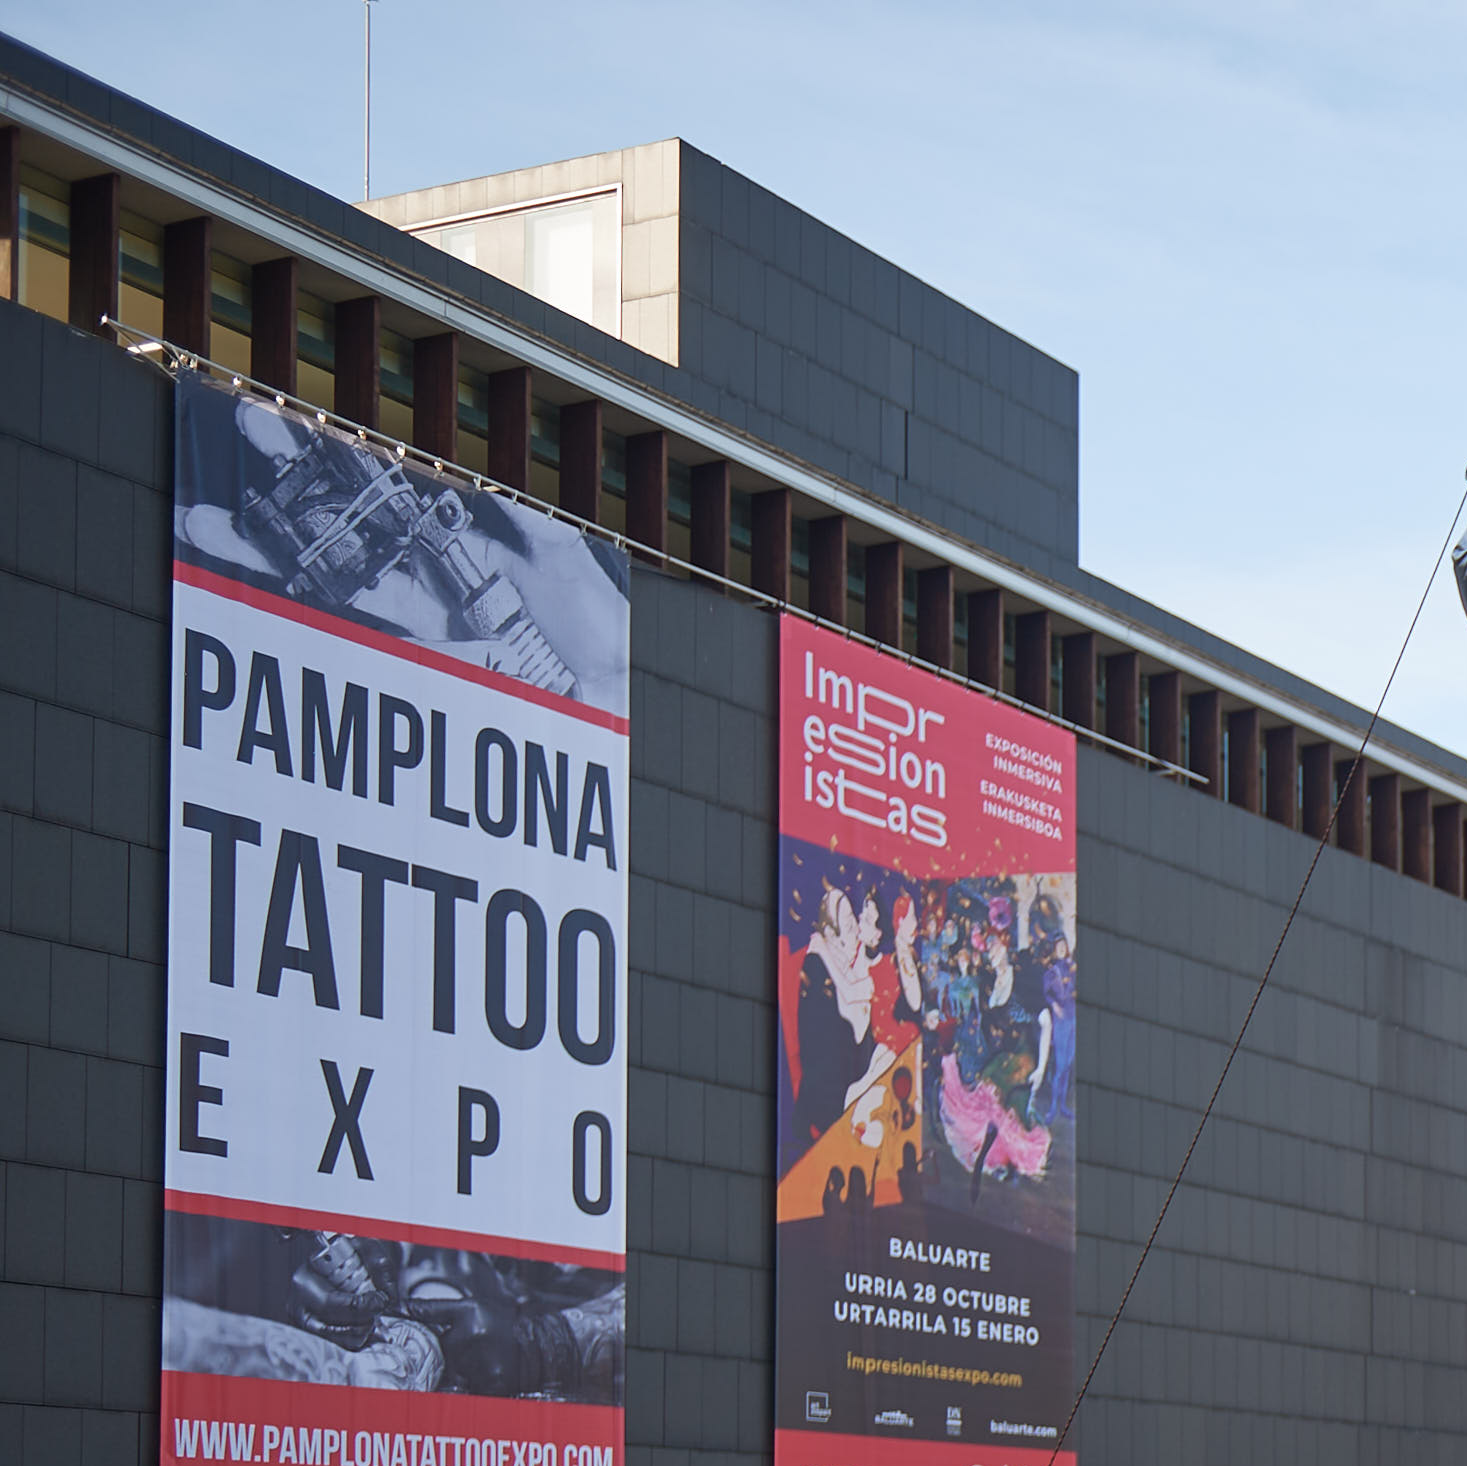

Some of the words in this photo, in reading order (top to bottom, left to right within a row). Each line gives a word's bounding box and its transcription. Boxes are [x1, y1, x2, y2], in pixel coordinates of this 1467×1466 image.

[183, 628, 617, 870] PAMPLONA
[985, 732, 1062, 774] EXPOSICIÓN
[993, 755, 1062, 794] INMERSIVA
[980, 779, 1062, 822] ERAKUSKETA
[982, 799, 1062, 841] INMERSIBOA
[183, 801, 616, 1066] TATTOO
[889, 1237, 991, 1272] BALUARTE
[845, 1272, 907, 1300] URRIA
[913, 1283, 937, 1305] 28
[943, 1287, 1031, 1317] OCTUBRE
[834, 1300, 947, 1335] URTARRILA
[953, 1316, 971, 1338] 15
[977, 1321, 1039, 1346] ENERO
[847, 1351, 1023, 1388] impresionistasexpo.com
[990, 1419, 1058, 1438] baluarte.com
